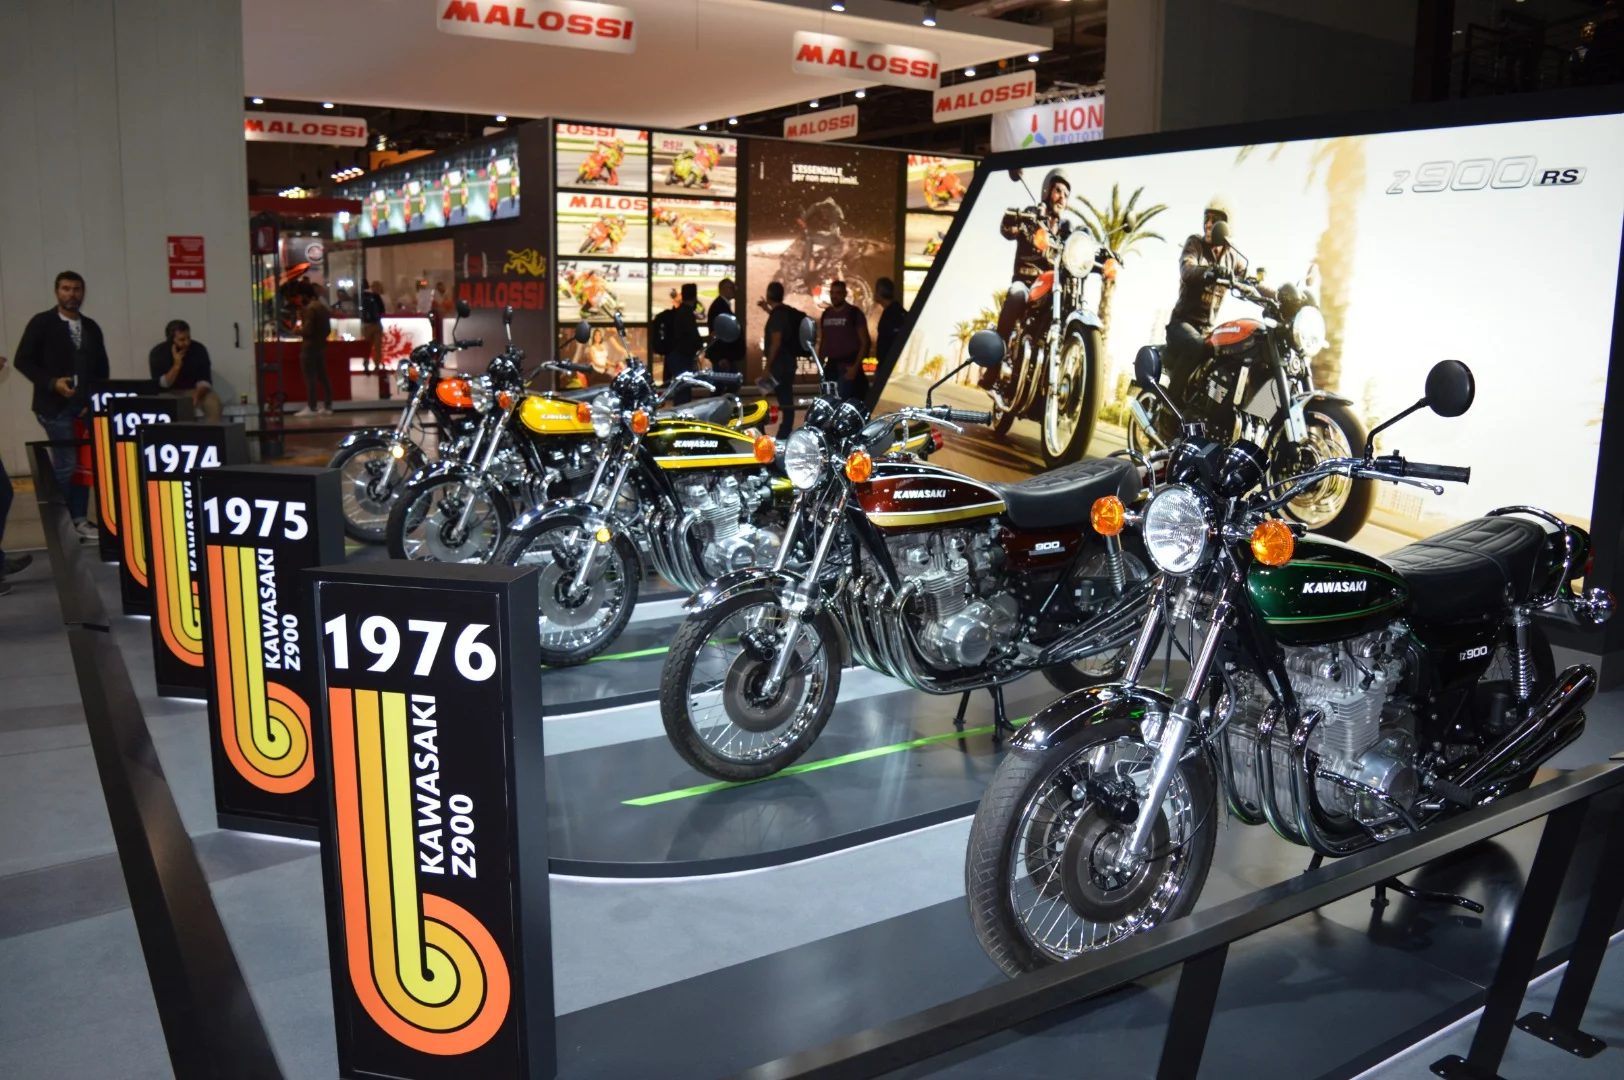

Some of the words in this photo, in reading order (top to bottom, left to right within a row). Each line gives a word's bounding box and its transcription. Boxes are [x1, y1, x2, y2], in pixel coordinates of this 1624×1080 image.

[442, 0, 634, 40] MALOSSI
[795, 43, 938, 80] MALOSSI
[935, 81, 1033, 114] MALOSSI
[244, 119, 365, 139] MALOSSI
[786, 113, 856, 138] MALOSSI
[1053, 104, 1104, 133] HON
[1540, 168, 1579, 184] RS
[458, 281, 545, 310] MALOSSI
[144, 444, 222, 473] 1974
[673, 439, 719, 449] KAWASAKI
[892, 489, 947, 500] KAWASAKI
[203, 496, 309, 540] 1975
[1034, 540, 1060, 551] 900
[1302, 580, 1368, 594] KAWASAKI
[258, 548, 281, 670] KAWASAKI
[282, 614, 301, 671] Z900
[324, 613, 497, 682] 1976
[411, 694, 445, 875] KAWASAKI
[449, 793, 477, 879] Z900
